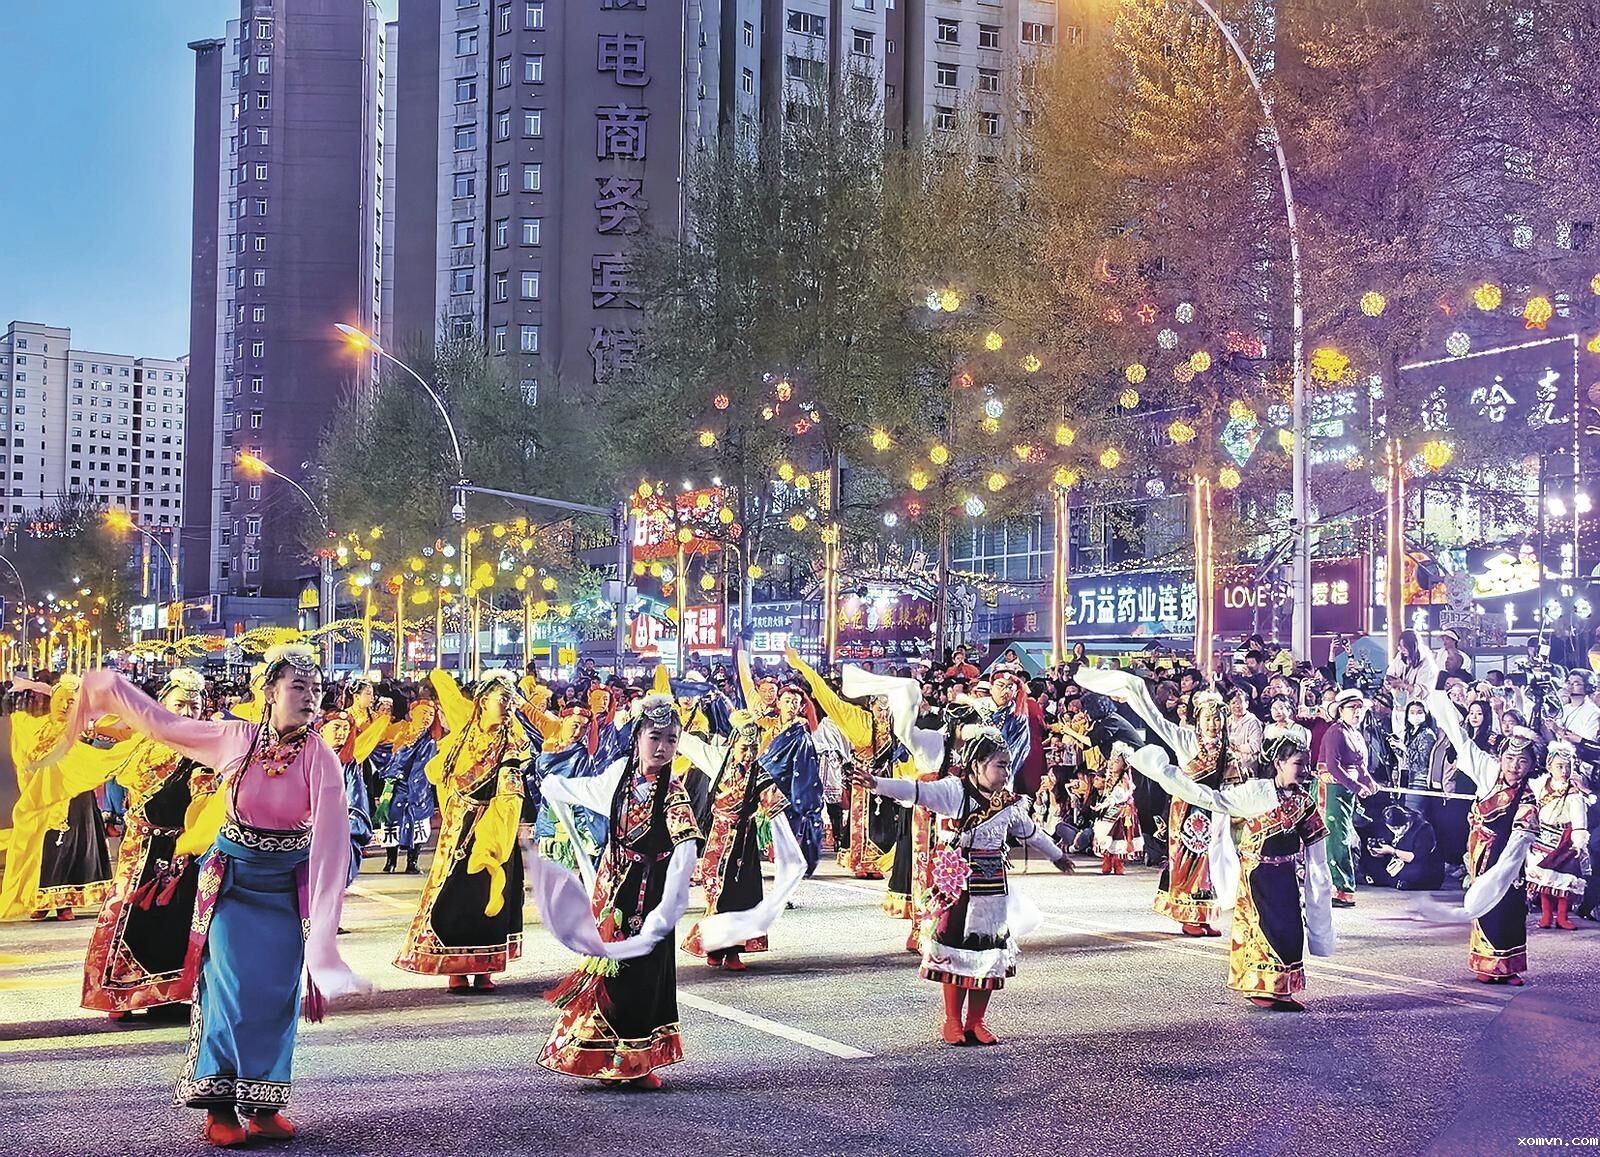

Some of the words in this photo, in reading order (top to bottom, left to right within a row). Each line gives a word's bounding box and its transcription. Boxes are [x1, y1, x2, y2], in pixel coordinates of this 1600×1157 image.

[588, 0, 651, 384] 电商务宾馆
[1224, 585, 1267, 608] LOVE
